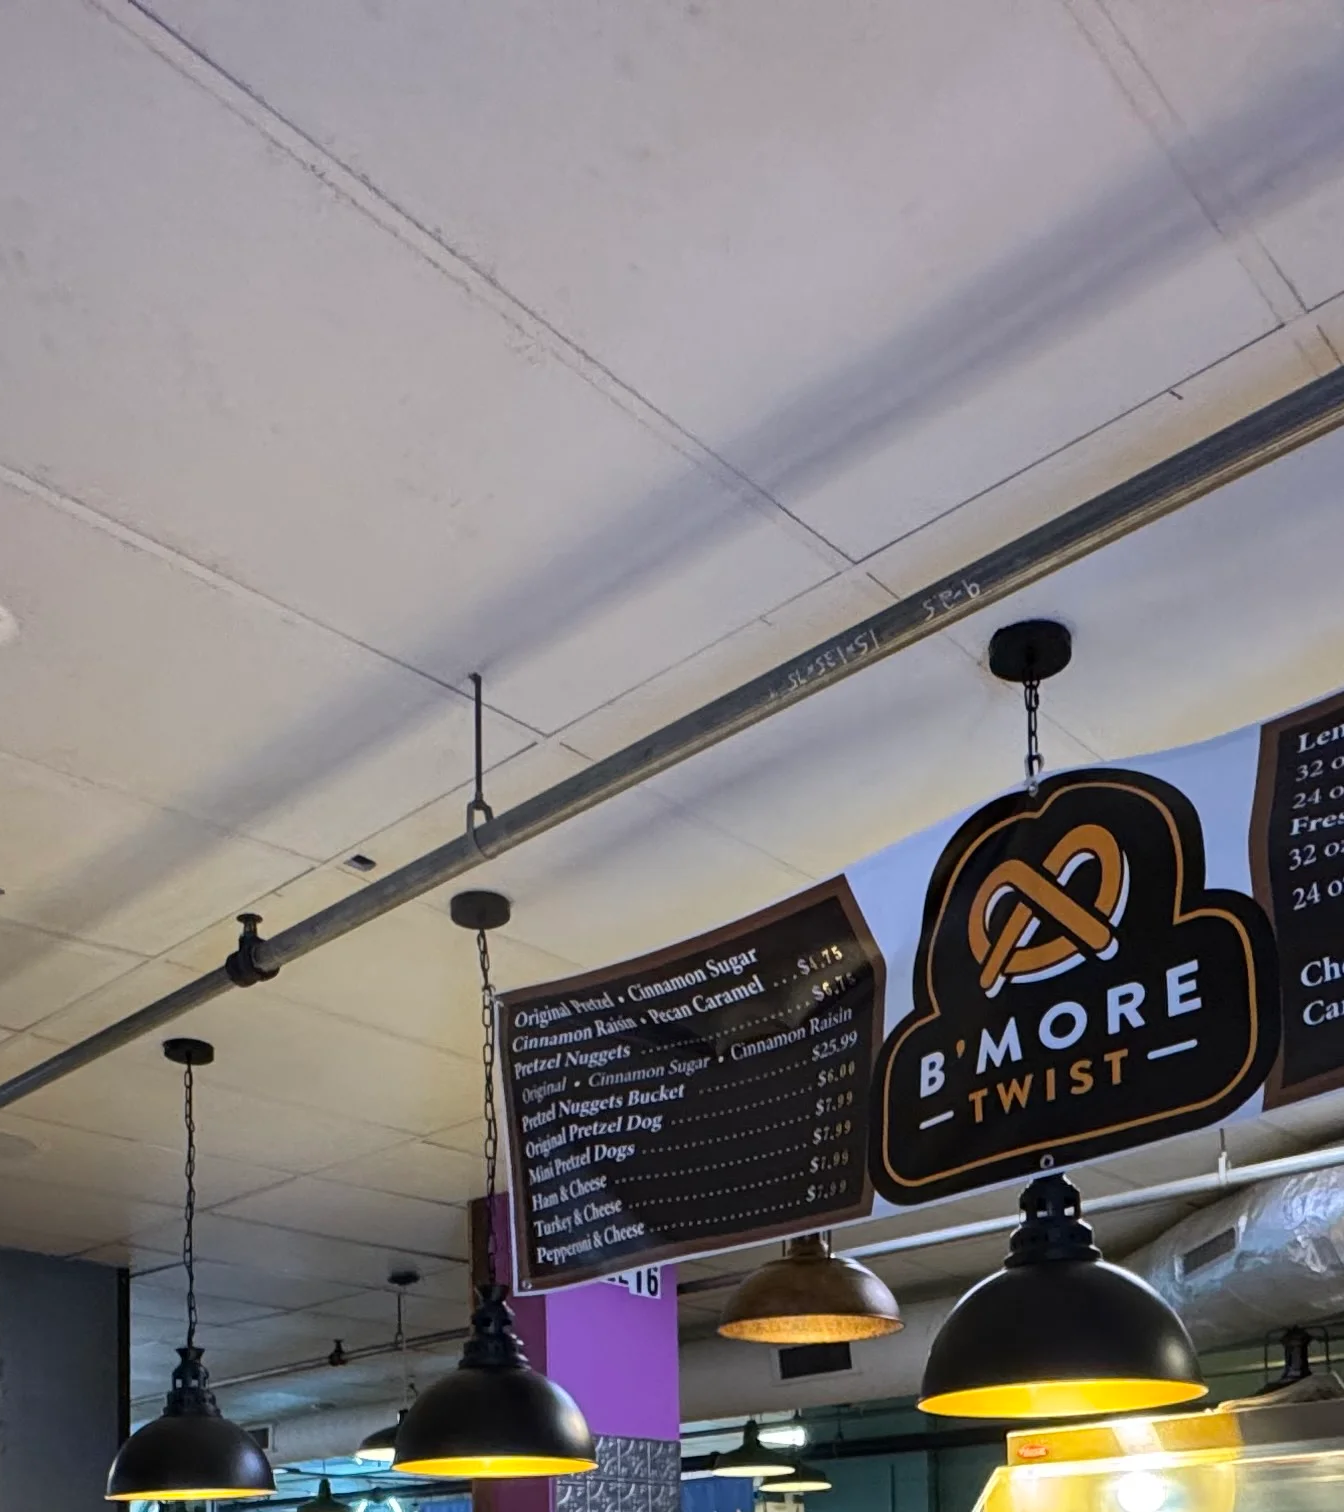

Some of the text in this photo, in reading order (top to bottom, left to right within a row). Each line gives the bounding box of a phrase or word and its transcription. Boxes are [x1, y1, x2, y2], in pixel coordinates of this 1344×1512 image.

[1291, 787, 1322, 810] 24
[1295, 759, 1324, 782] 32
[1288, 847, 1317, 872] 32
[1292, 886, 1321, 911] 24
[512, 945, 843, 1053] Cinnamon Raisin Pecan Caramel $4.75
[514, 948, 758, 1029] Original Pretzel Cinnamon Sugar
[514, 1052, 562, 1080] Pretzel
[564, 1045, 631, 1068] Nuggets
[522, 1006, 854, 1104] Original Cinnamon Sugar Cinnamon Raisin
[920, 959, 1202, 1099] B'MORE
[521, 1030, 858, 1133] Pretzel Nuggets Bucket $25.99
[525, 1060, 856, 1158] Original Pretzel Dog $6.00
[968, 1048, 1129, 1124] TWIST
[527, 1090, 854, 1186] Mini Pretzel Dogs $7.99
[531, 1119, 852, 1212] Ham & Cheese $7.99
[534, 1216, 573, 1238] Turkey
[573, 1208, 583, 1226] &
[583, 1199, 623, 1223] Cheese
[536, 1238, 592, 1265] Pepperoni
[593, 1231, 604, 1249] &
[604, 1222, 645, 1246] Cheese
[636, 1267, 659, 1297] 16
